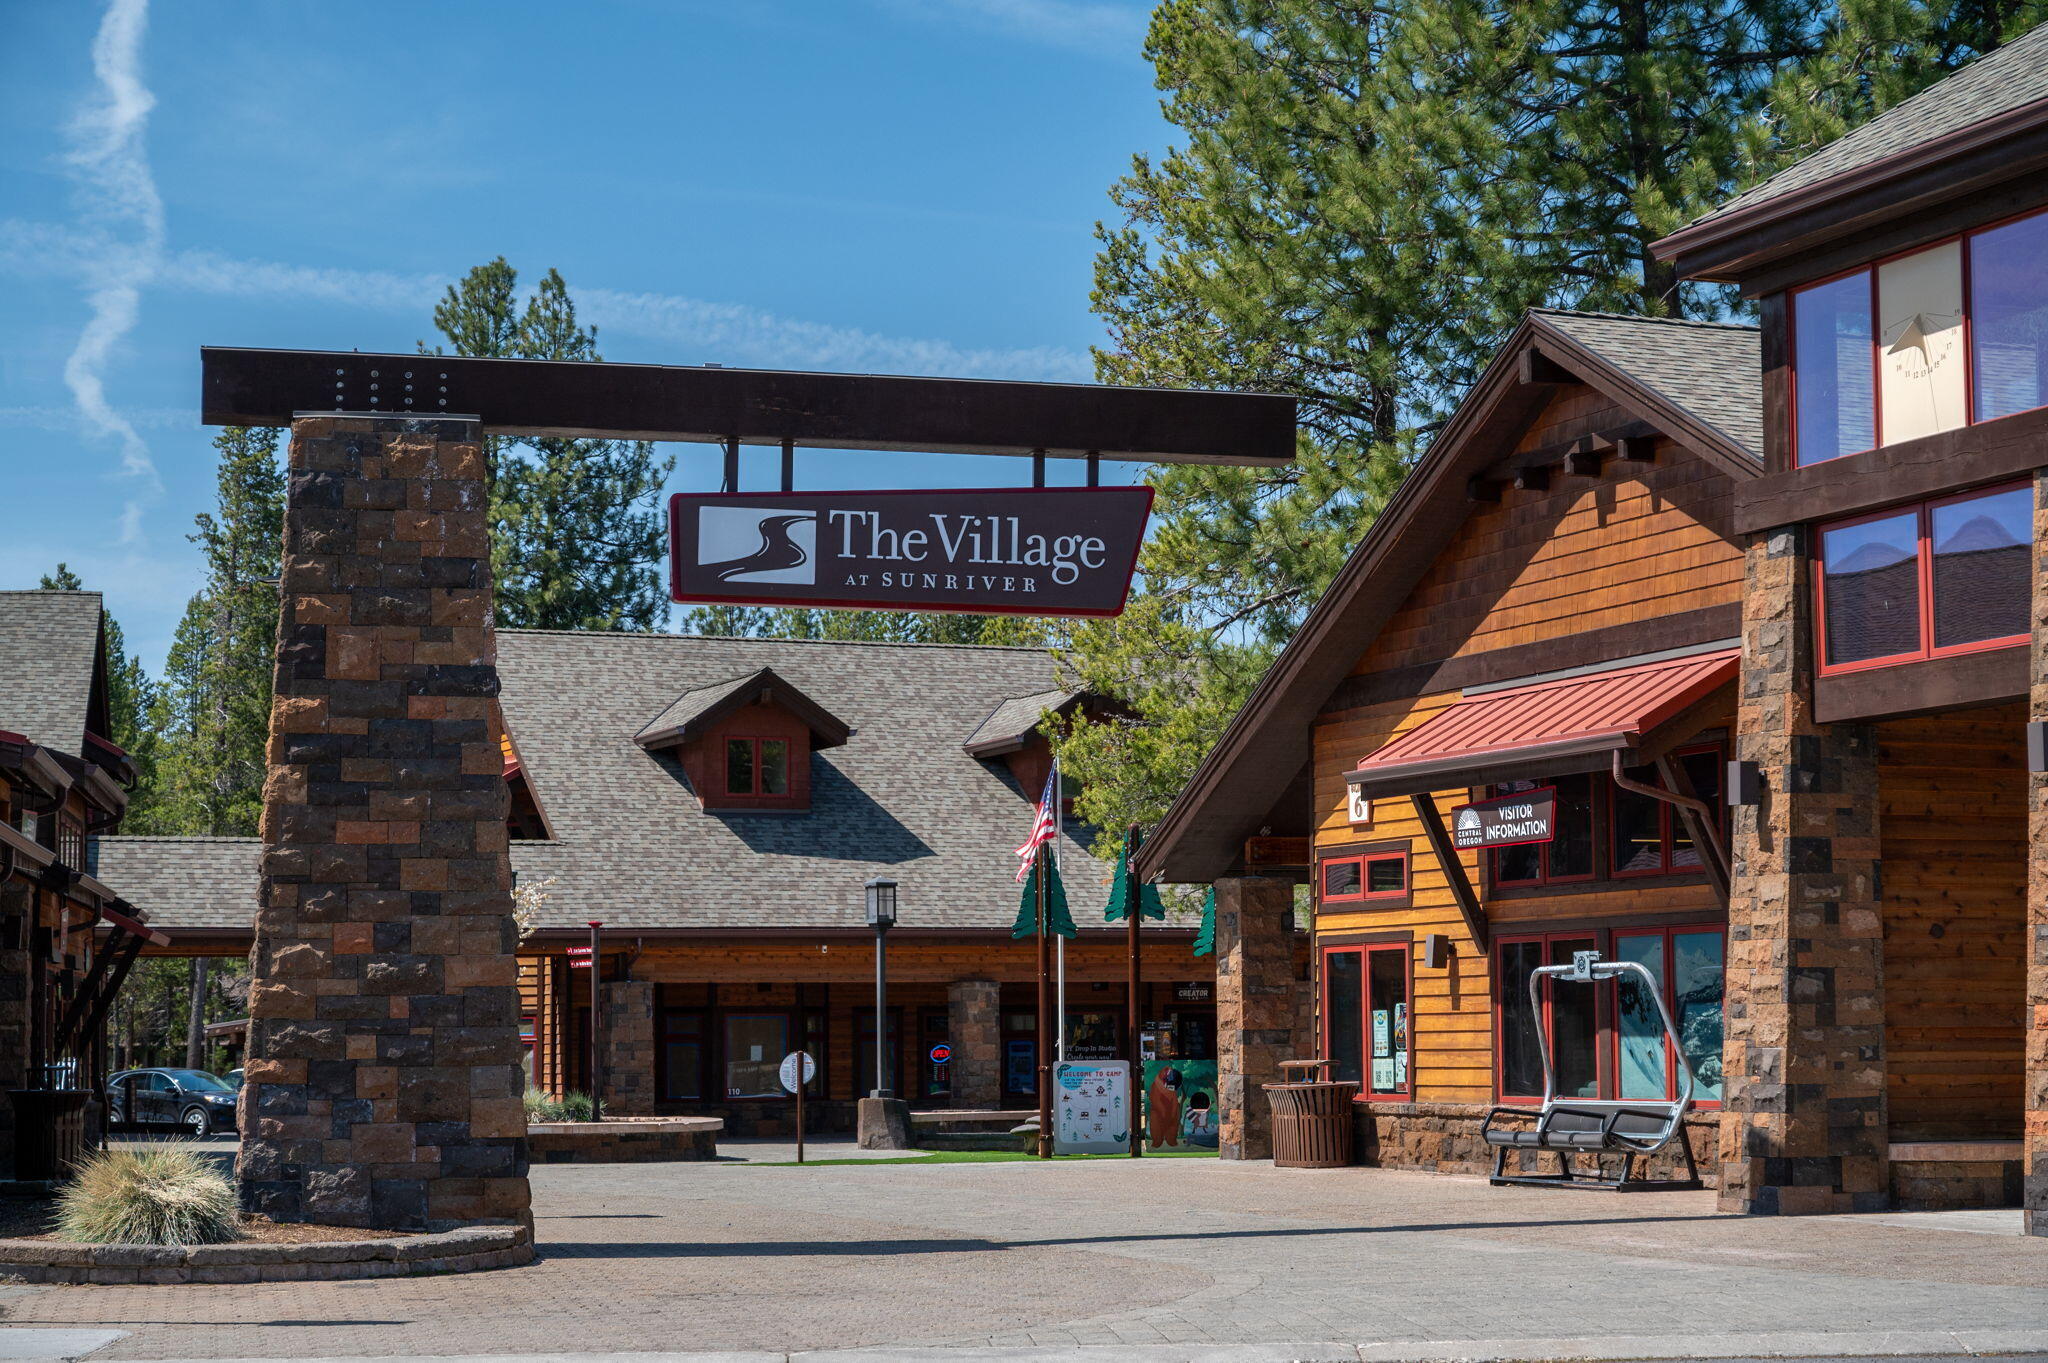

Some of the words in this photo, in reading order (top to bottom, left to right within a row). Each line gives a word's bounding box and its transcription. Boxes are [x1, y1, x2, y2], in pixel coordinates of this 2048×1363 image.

[1913, 371, 1919, 379] 12
[1946, 342, 1952, 350] 17
[829, 509, 928, 562] The
[929, 513, 1106, 585] Village
[844, 573, 869, 586] AT
[881, 571, 1037, 592] SUNRIVER
[1355, 796, 1363, 817] 6
[1498, 803, 1533, 821] VISITOR
[1458, 829, 1482, 838] CENTRAL
[1486, 819, 1547, 840] INFORMATION
[1458, 837, 1483, 846] OREGON
[1178, 989, 1209, 997] CREATOR
[932, 1049, 950, 1058] OPEN
[727, 1088, 741, 1096] 110
